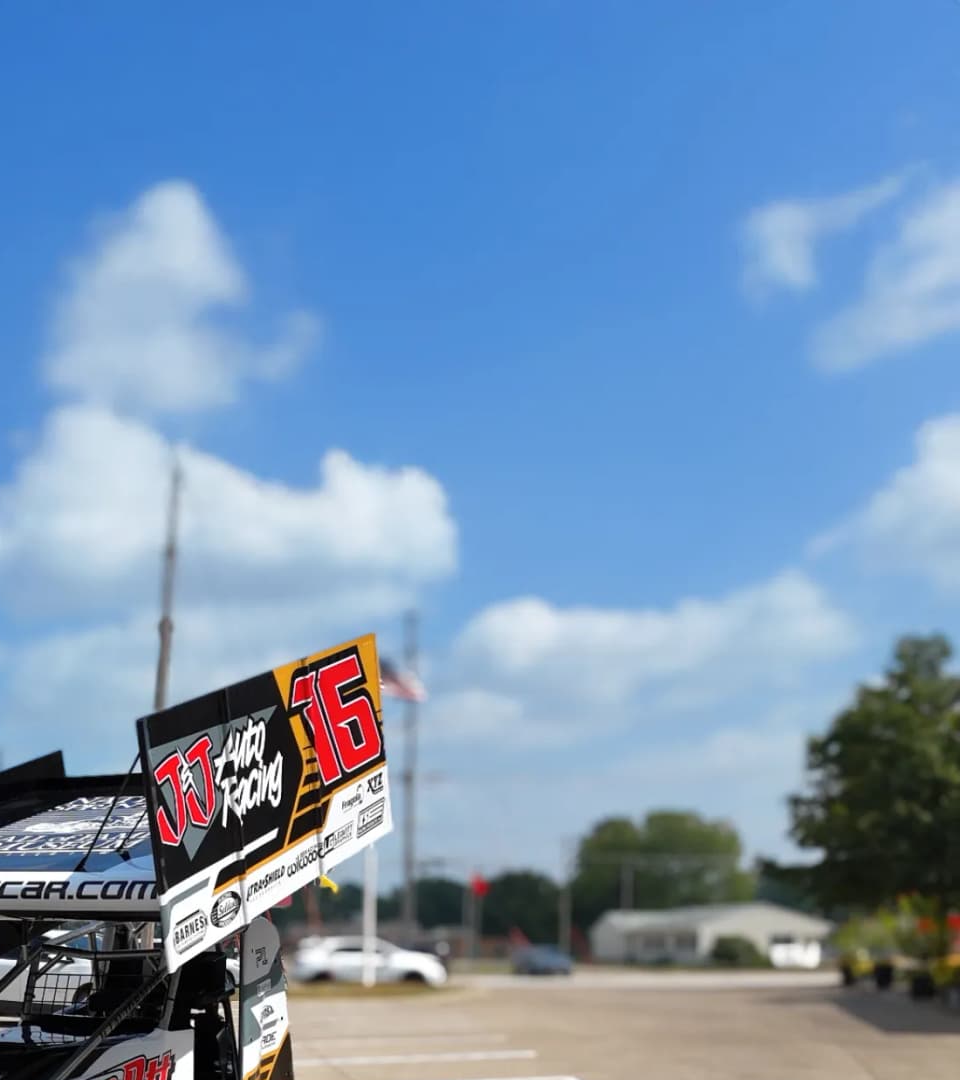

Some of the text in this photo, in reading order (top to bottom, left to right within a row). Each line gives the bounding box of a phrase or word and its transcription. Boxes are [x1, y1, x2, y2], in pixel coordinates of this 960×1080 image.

[214, 718, 266, 786] Auto
[291, 653, 382, 786] 16
[220, 751, 283, 828] Racing
[174, 915, 205, 945] BARNES
